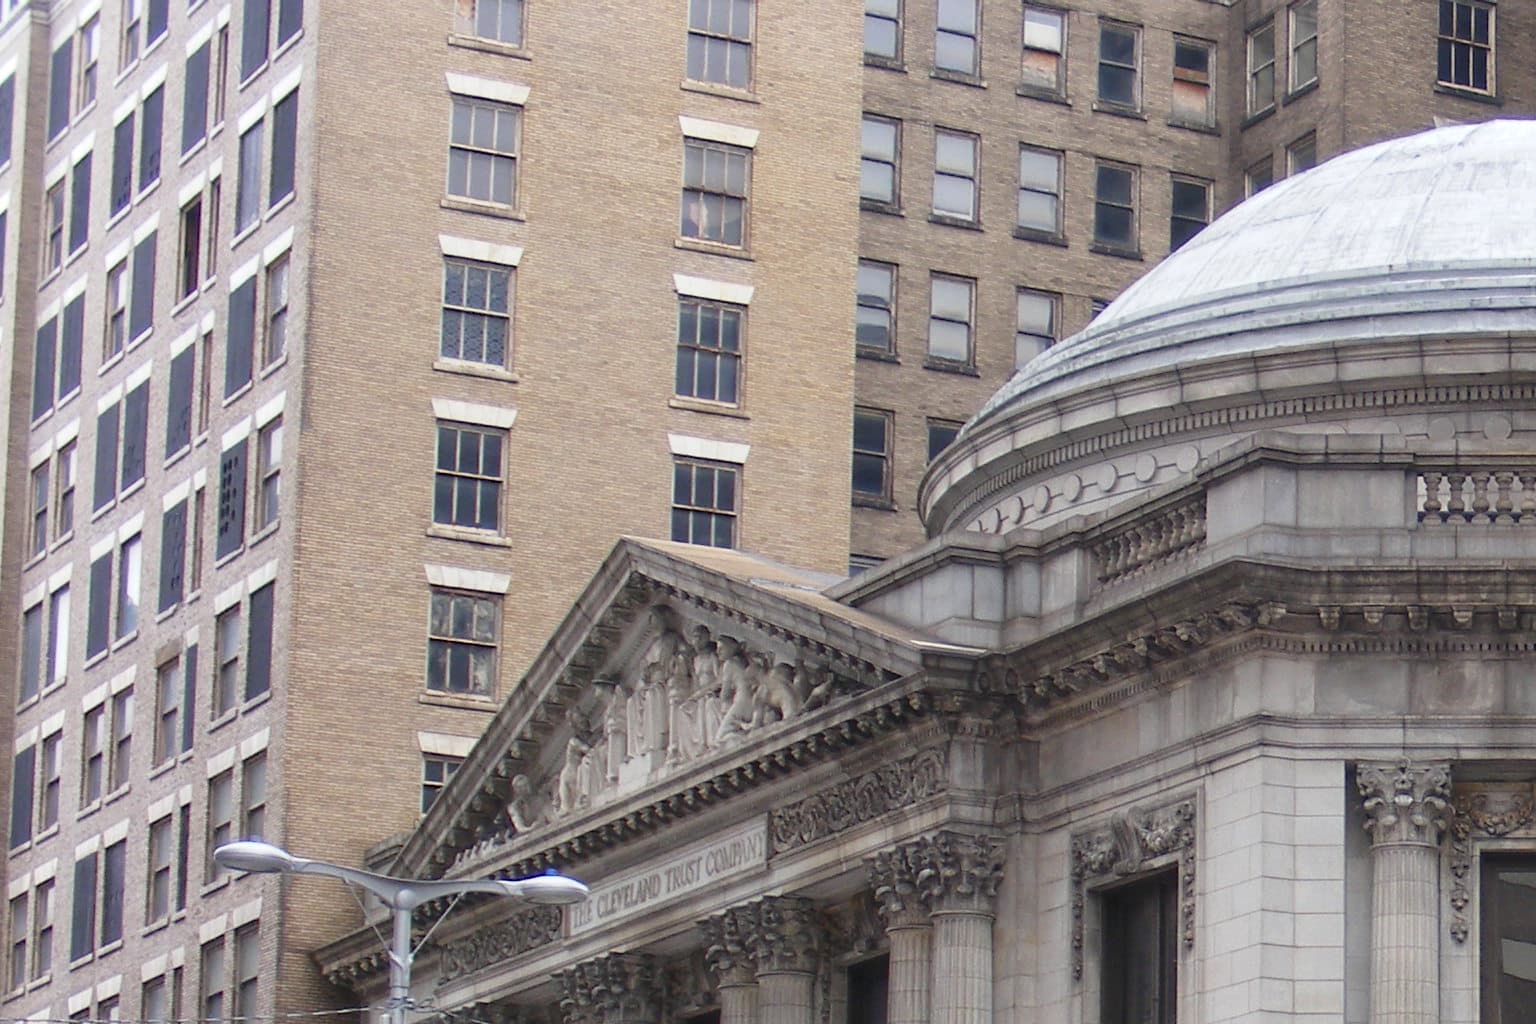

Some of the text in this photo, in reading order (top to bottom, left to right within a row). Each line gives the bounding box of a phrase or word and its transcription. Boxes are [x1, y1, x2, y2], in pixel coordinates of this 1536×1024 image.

[597, 873, 661, 918] CLEVELAND
[664, 855, 702, 893] TRUST
[705, 830, 767, 876] COMPANY
